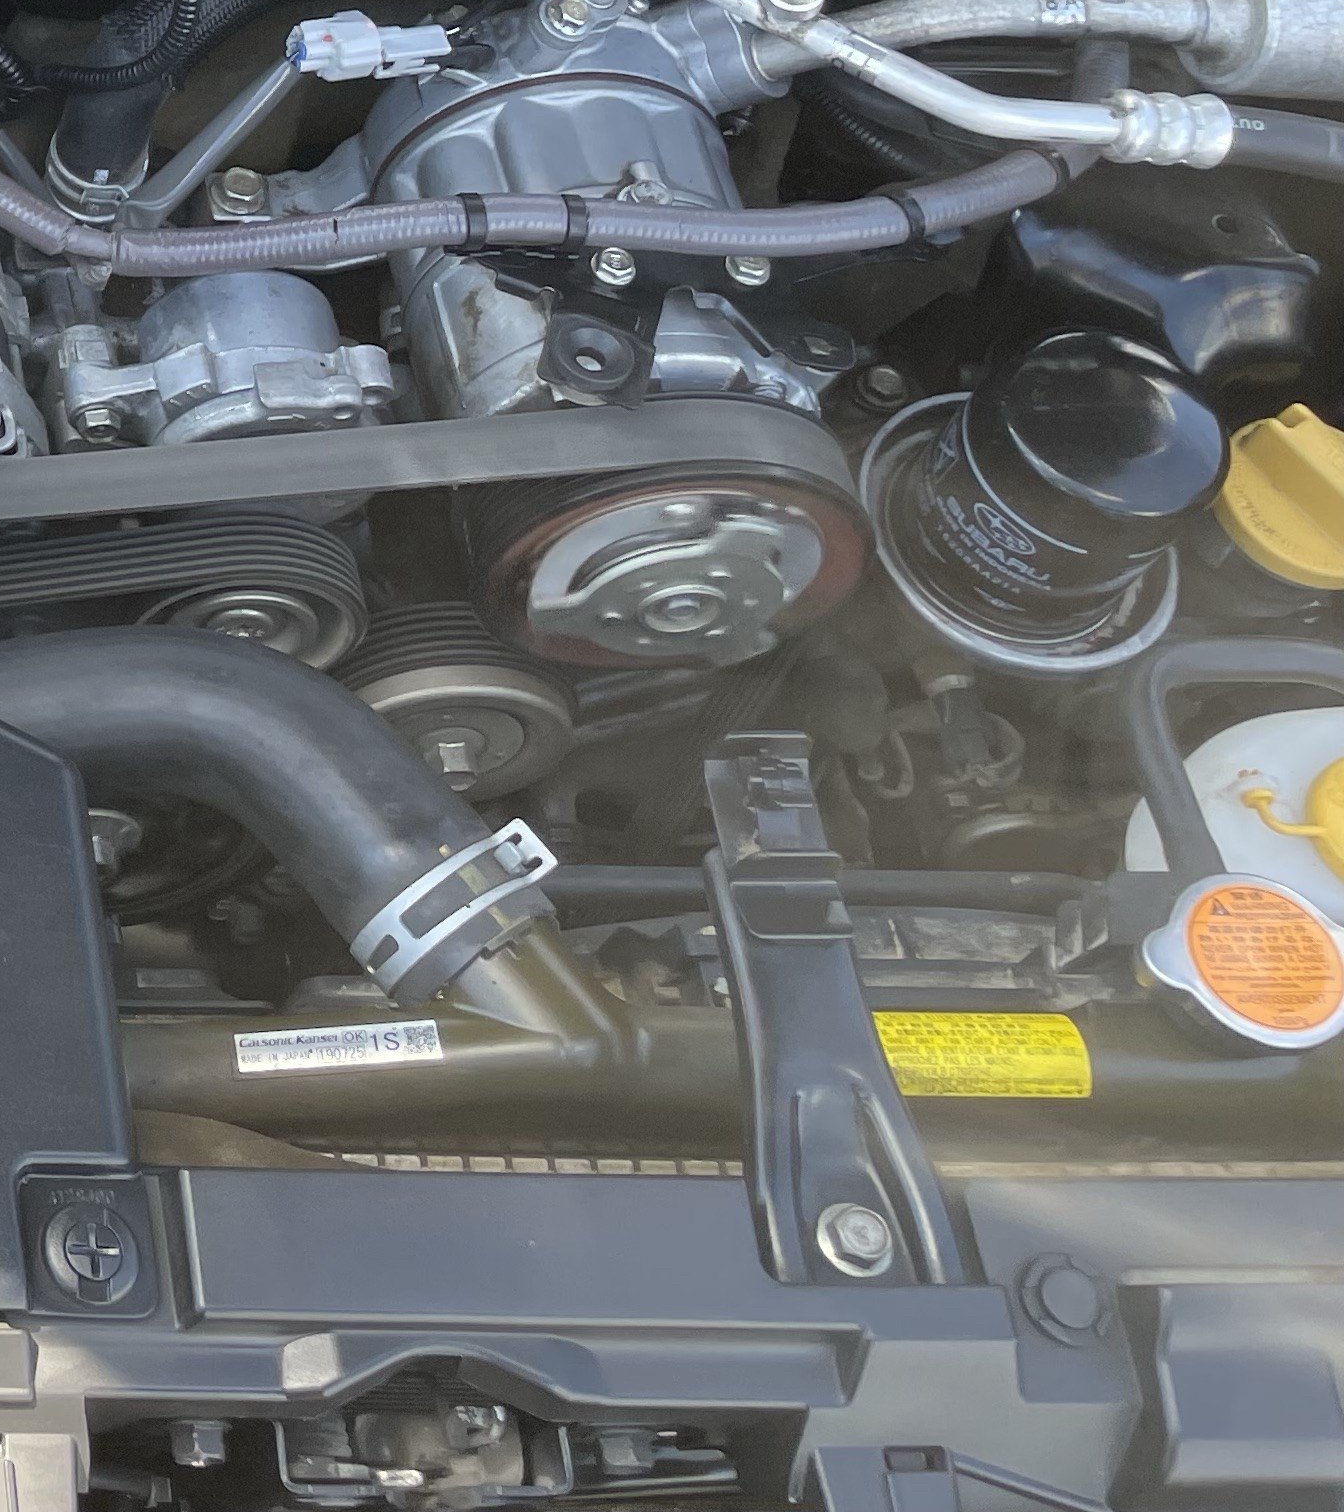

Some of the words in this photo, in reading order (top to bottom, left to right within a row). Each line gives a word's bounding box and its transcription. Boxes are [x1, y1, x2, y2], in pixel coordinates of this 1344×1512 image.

[946, 495, 1051, 581] SUBARU
[239, 1036, 293, 1048] Calsonic
[296, 1034, 339, 1045] Kansei
[343, 1031, 365, 1043] OK
[240, 1053, 263, 1063] MADE
